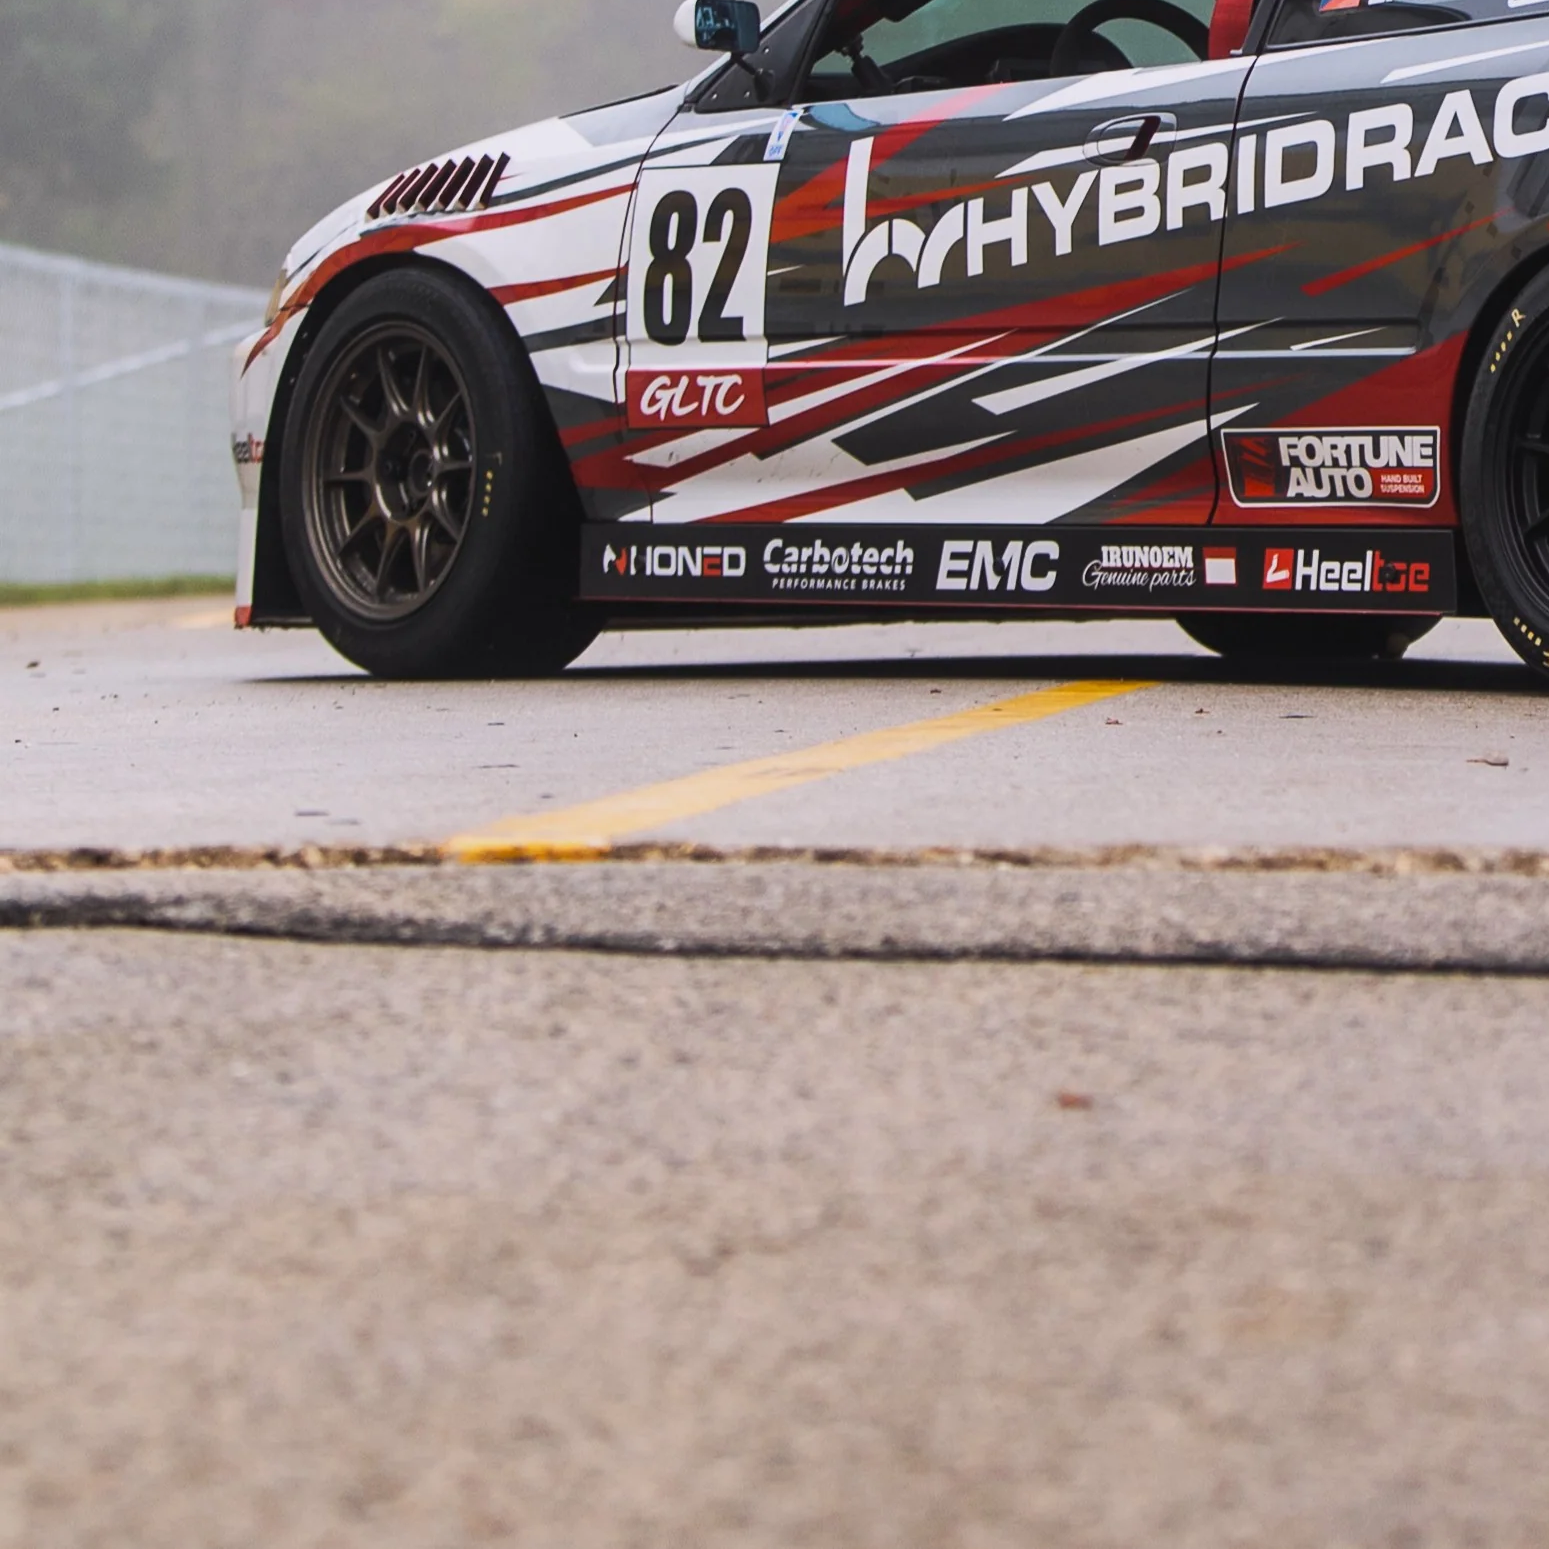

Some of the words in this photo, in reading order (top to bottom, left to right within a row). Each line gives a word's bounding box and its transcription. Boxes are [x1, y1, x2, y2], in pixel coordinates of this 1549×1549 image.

[643, 187, 754, 347] 82
[639, 374, 745, 422] GLTC
[1278, 435, 1434, 468] FORTUNE
[1286, 467, 1373, 498] AUTO
[763, 538, 914, 574] Carbotech
[936, 540, 1060, 591] EMC
[1101, 545, 1194, 568] IRUNOEM
[771, 578, 856, 590] PERFORMANCE
[861, 578, 906, 591] BRAKES
[1082, 559, 1149, 590] Genuine
[1149, 568, 1197, 592] parts
